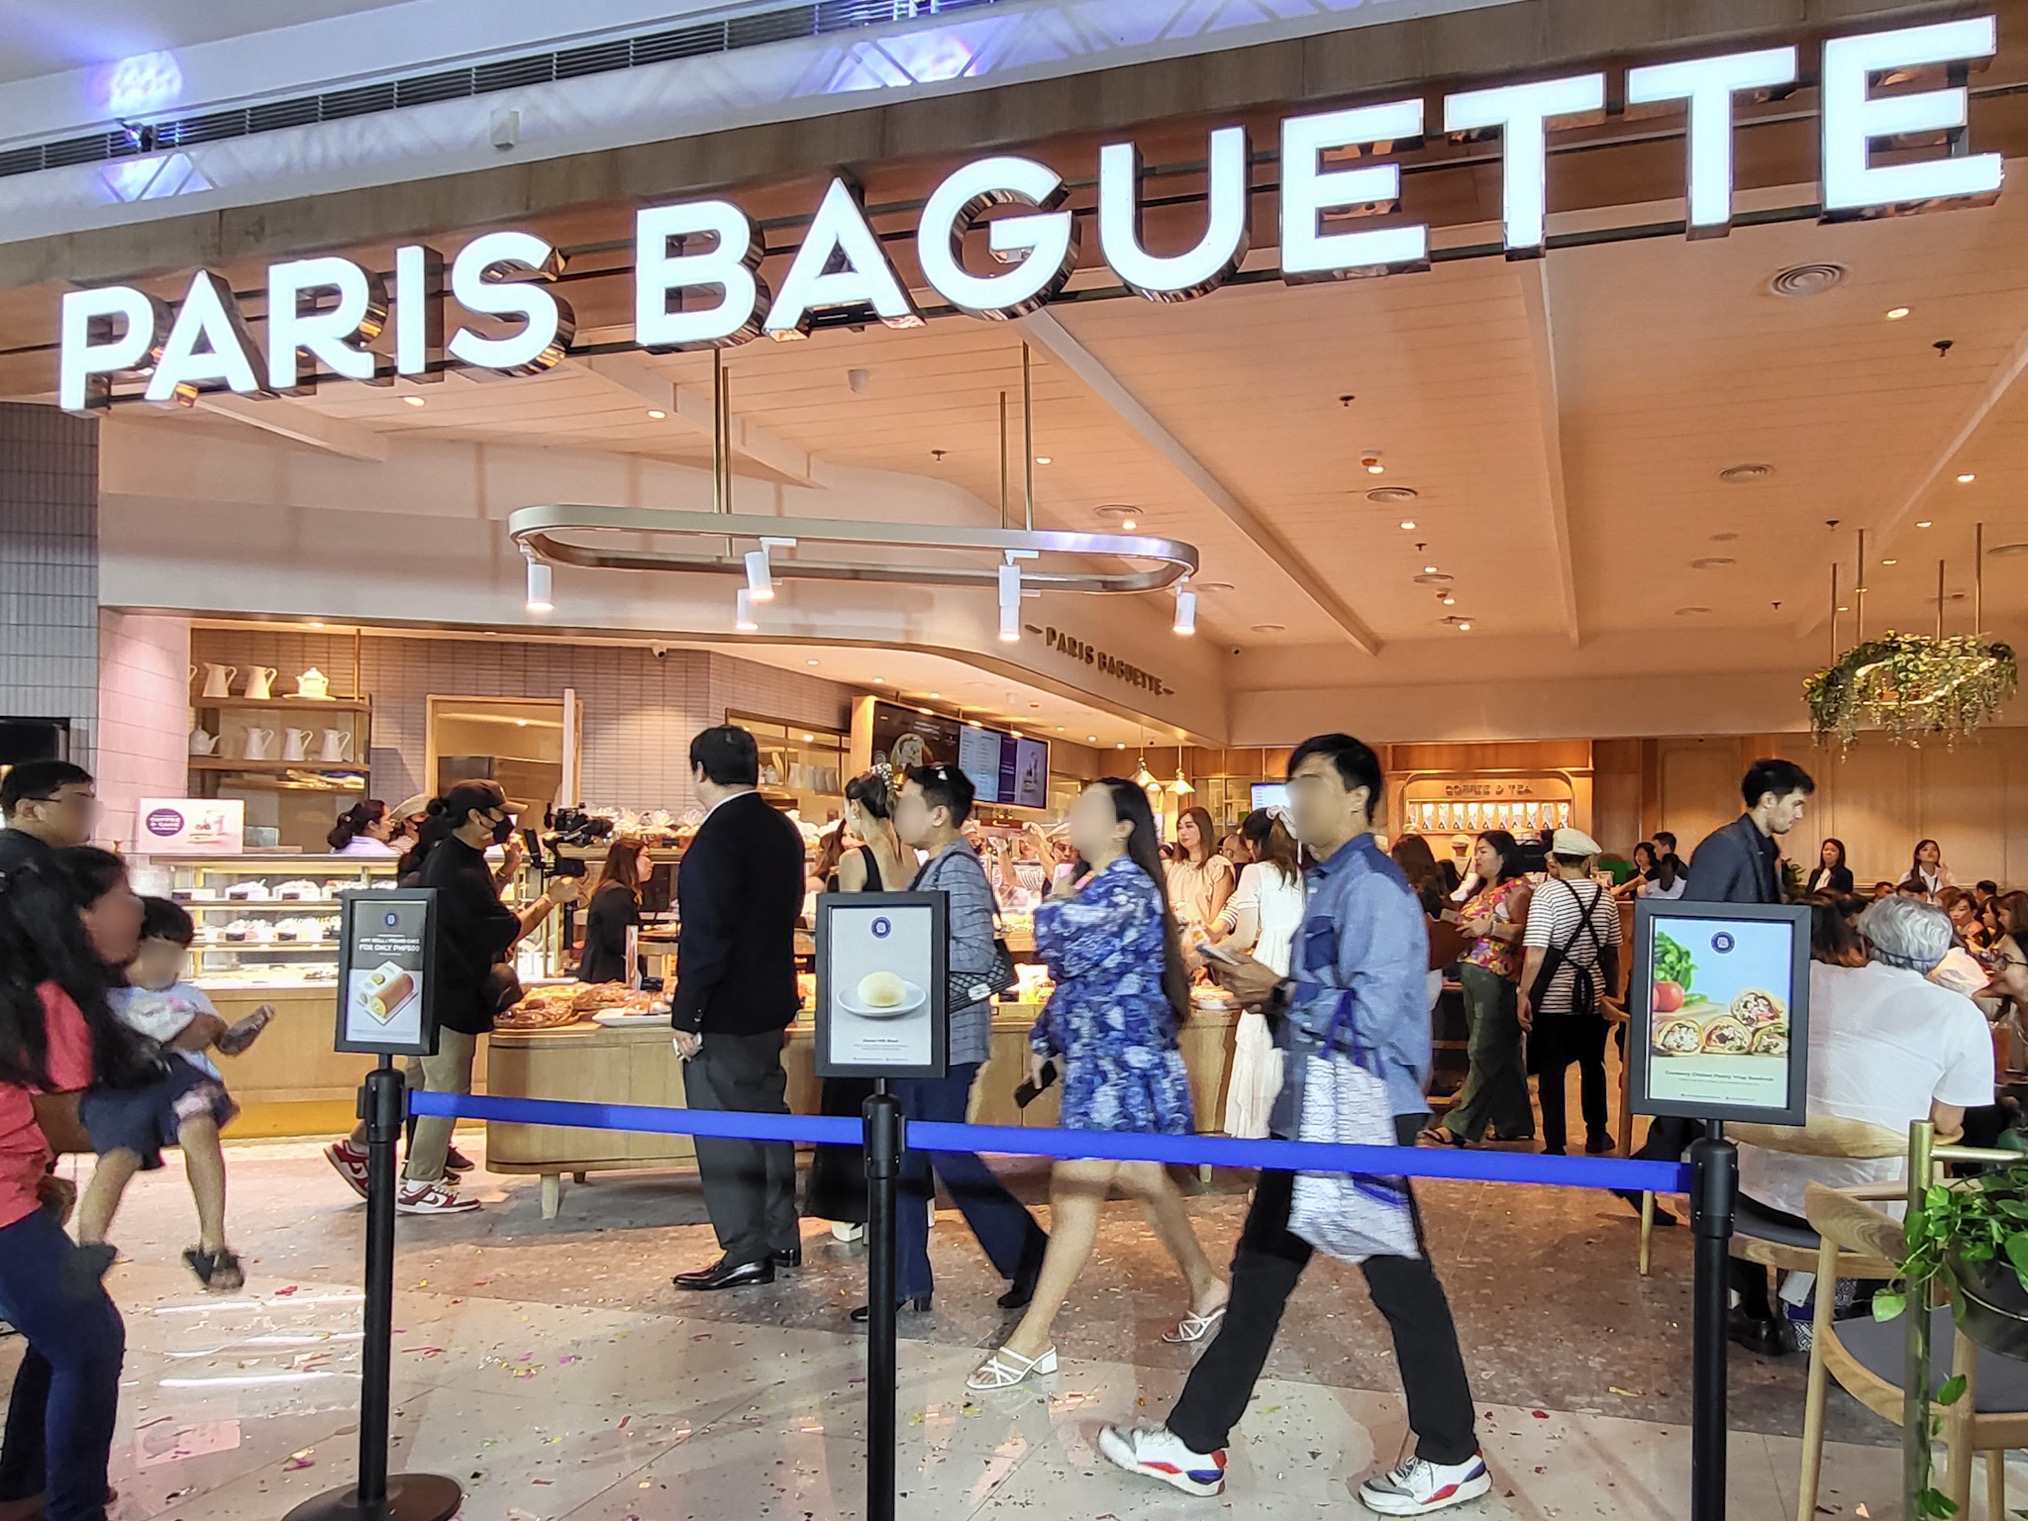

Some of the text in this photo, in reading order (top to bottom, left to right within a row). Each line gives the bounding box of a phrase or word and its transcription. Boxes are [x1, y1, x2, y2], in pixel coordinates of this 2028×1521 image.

[60, 15, 2003, 412] PARIS BAGUETTE
[1046, 626, 1163, 696] PARIS BAGUETTE
[1445, 785, 1490, 796] COFFEE
[1508, 784, 1533, 796] TEA
